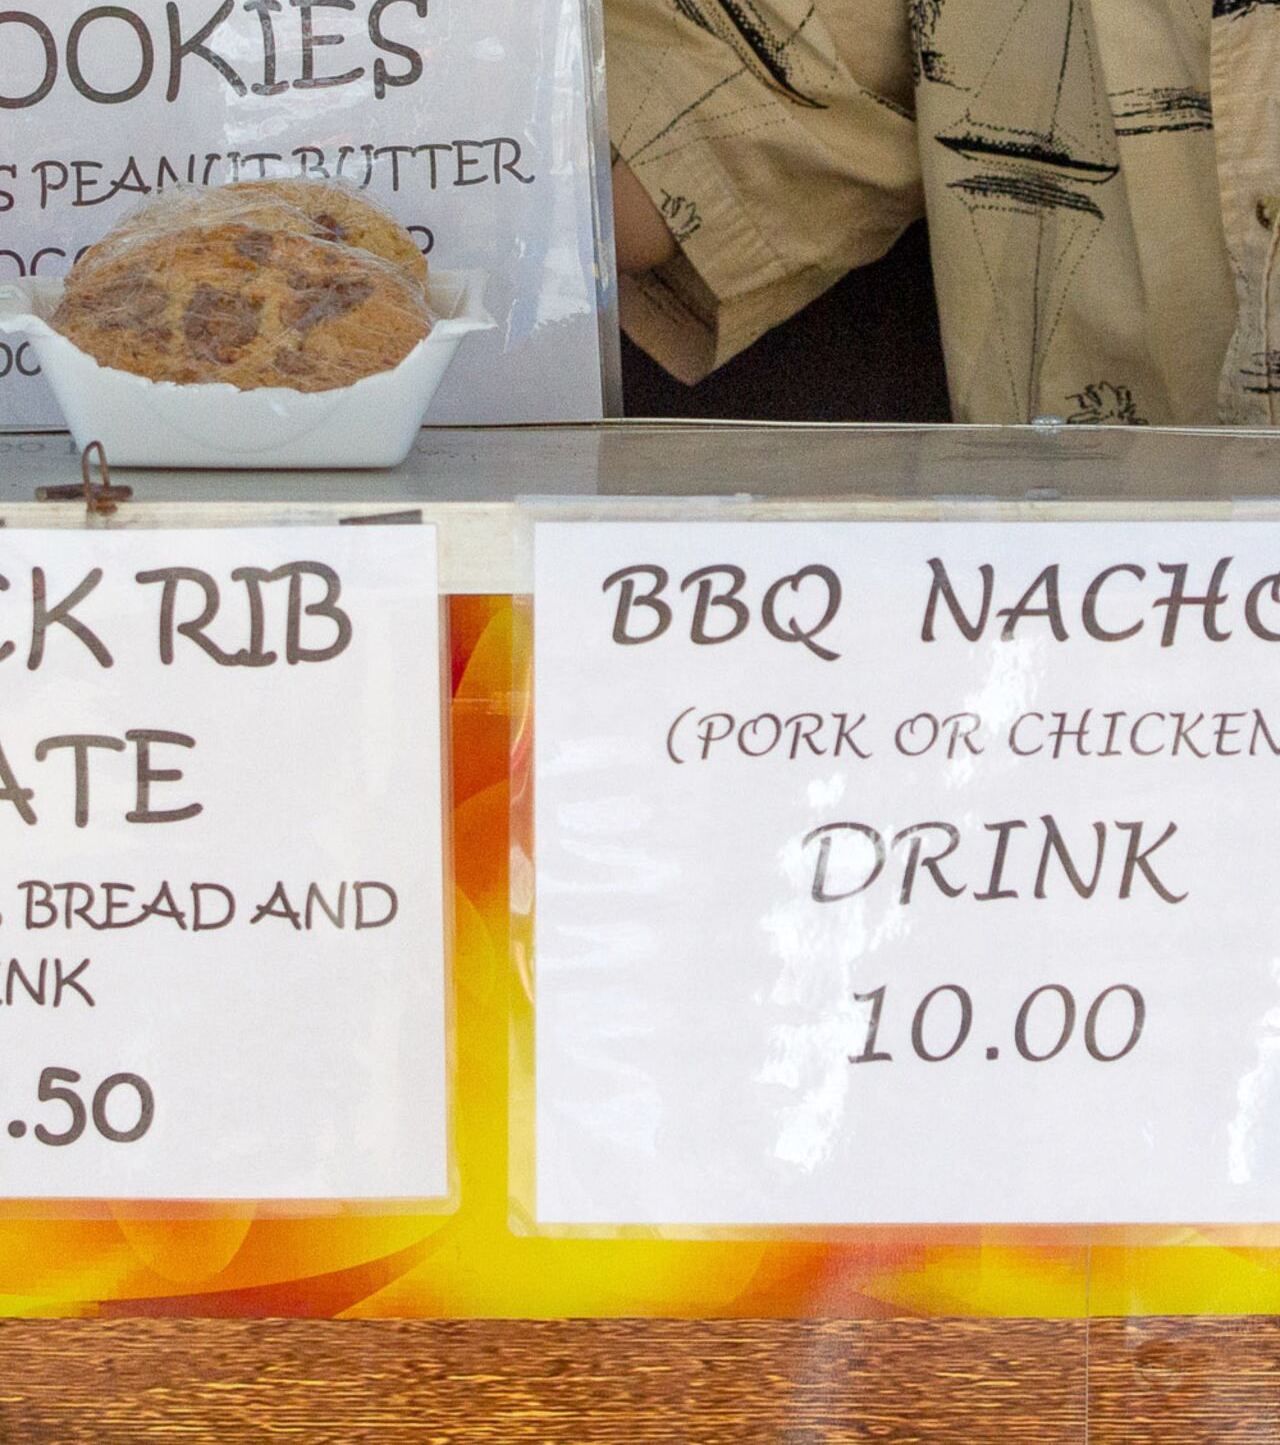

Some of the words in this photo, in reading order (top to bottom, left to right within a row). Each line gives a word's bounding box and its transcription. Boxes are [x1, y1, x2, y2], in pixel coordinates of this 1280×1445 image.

[291, 137, 536, 192] BUTTER
[133, 559, 354, 669] RIB
[601, 562, 843, 663] BBQ
[665, 705, 872, 765] (PORK
[893, 711, 985, 761] OR
[799, 813, 1190, 906] DRINK
[16, 878, 237, 933] BREAD
[248, 879, 400, 932] AND
[847, 982, 1147, 1065] 10.00
